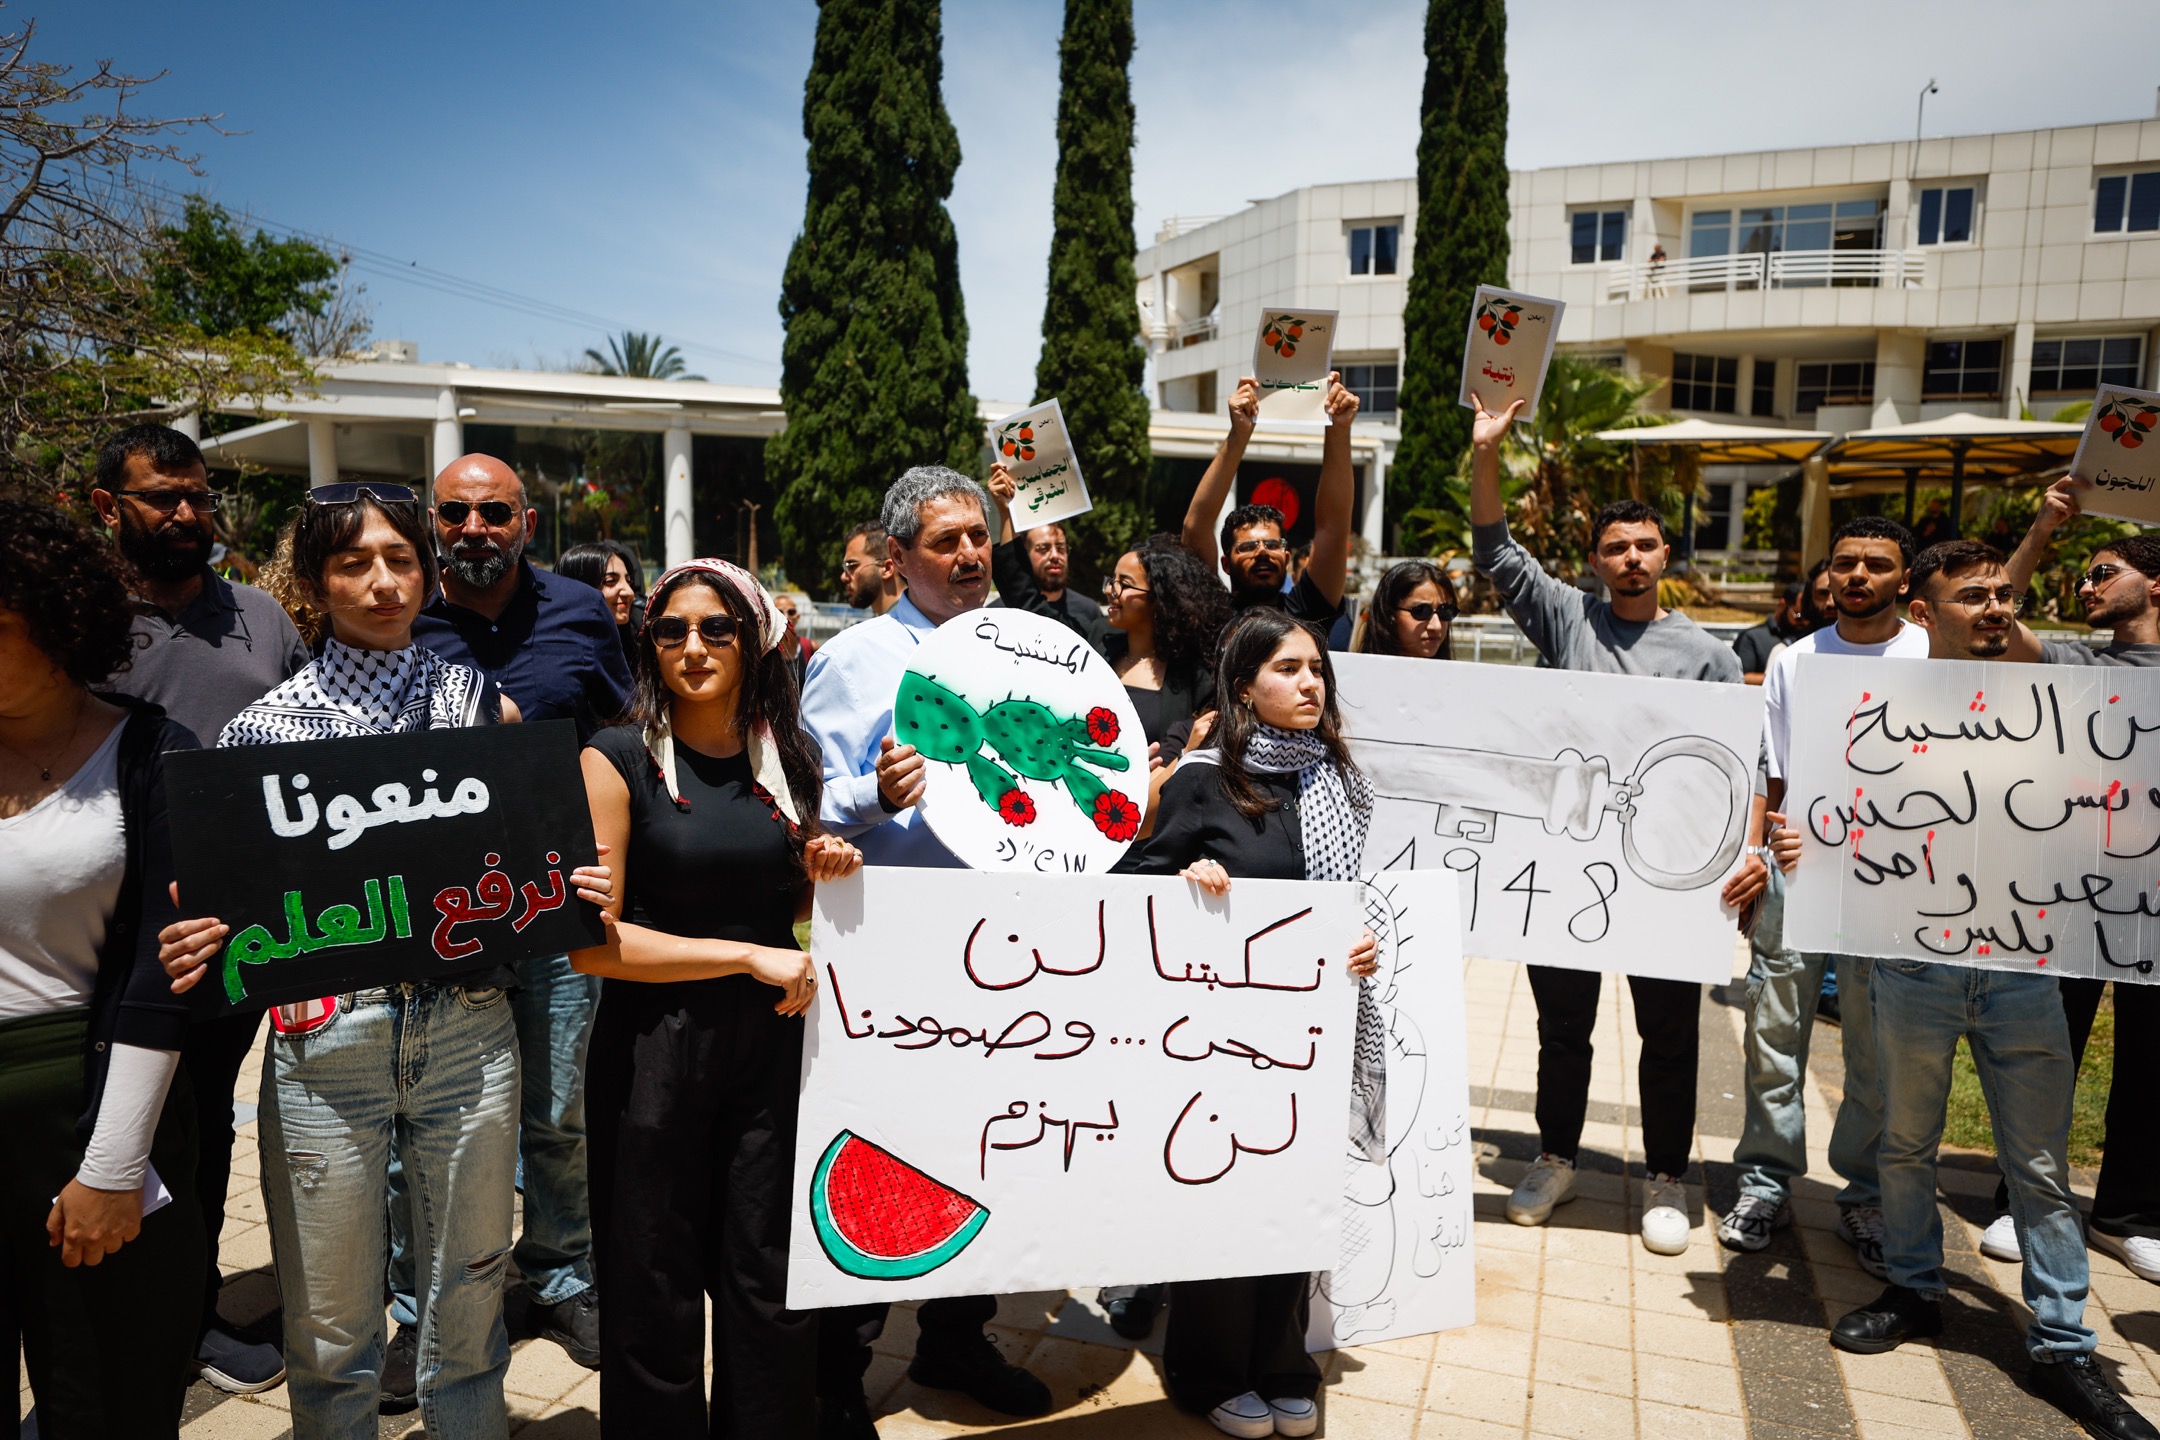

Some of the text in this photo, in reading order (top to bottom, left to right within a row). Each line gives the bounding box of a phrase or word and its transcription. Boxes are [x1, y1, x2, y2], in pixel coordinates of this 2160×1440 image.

[1016, 456, 1071, 491] الجماسين
[1028, 479, 1069, 513] الشرقي
[2095, 469, 2156, 492] اللجون
[975, 616, 1090, 674] المنشية
[1845, 683, 2065, 775] الشيخ
[262, 768, 490, 851] منعونا
[221, 850, 566, 1005] نرفع العلم
[963, 894, 1327, 992] نكبتنا لن
[2094, 919, 2154, 974] ما
[980, 1091, 1298, 1185] لن يهزم
[1424, 1114, 1466, 1151] نحن
[1410, 1148, 1455, 1198] هنا
